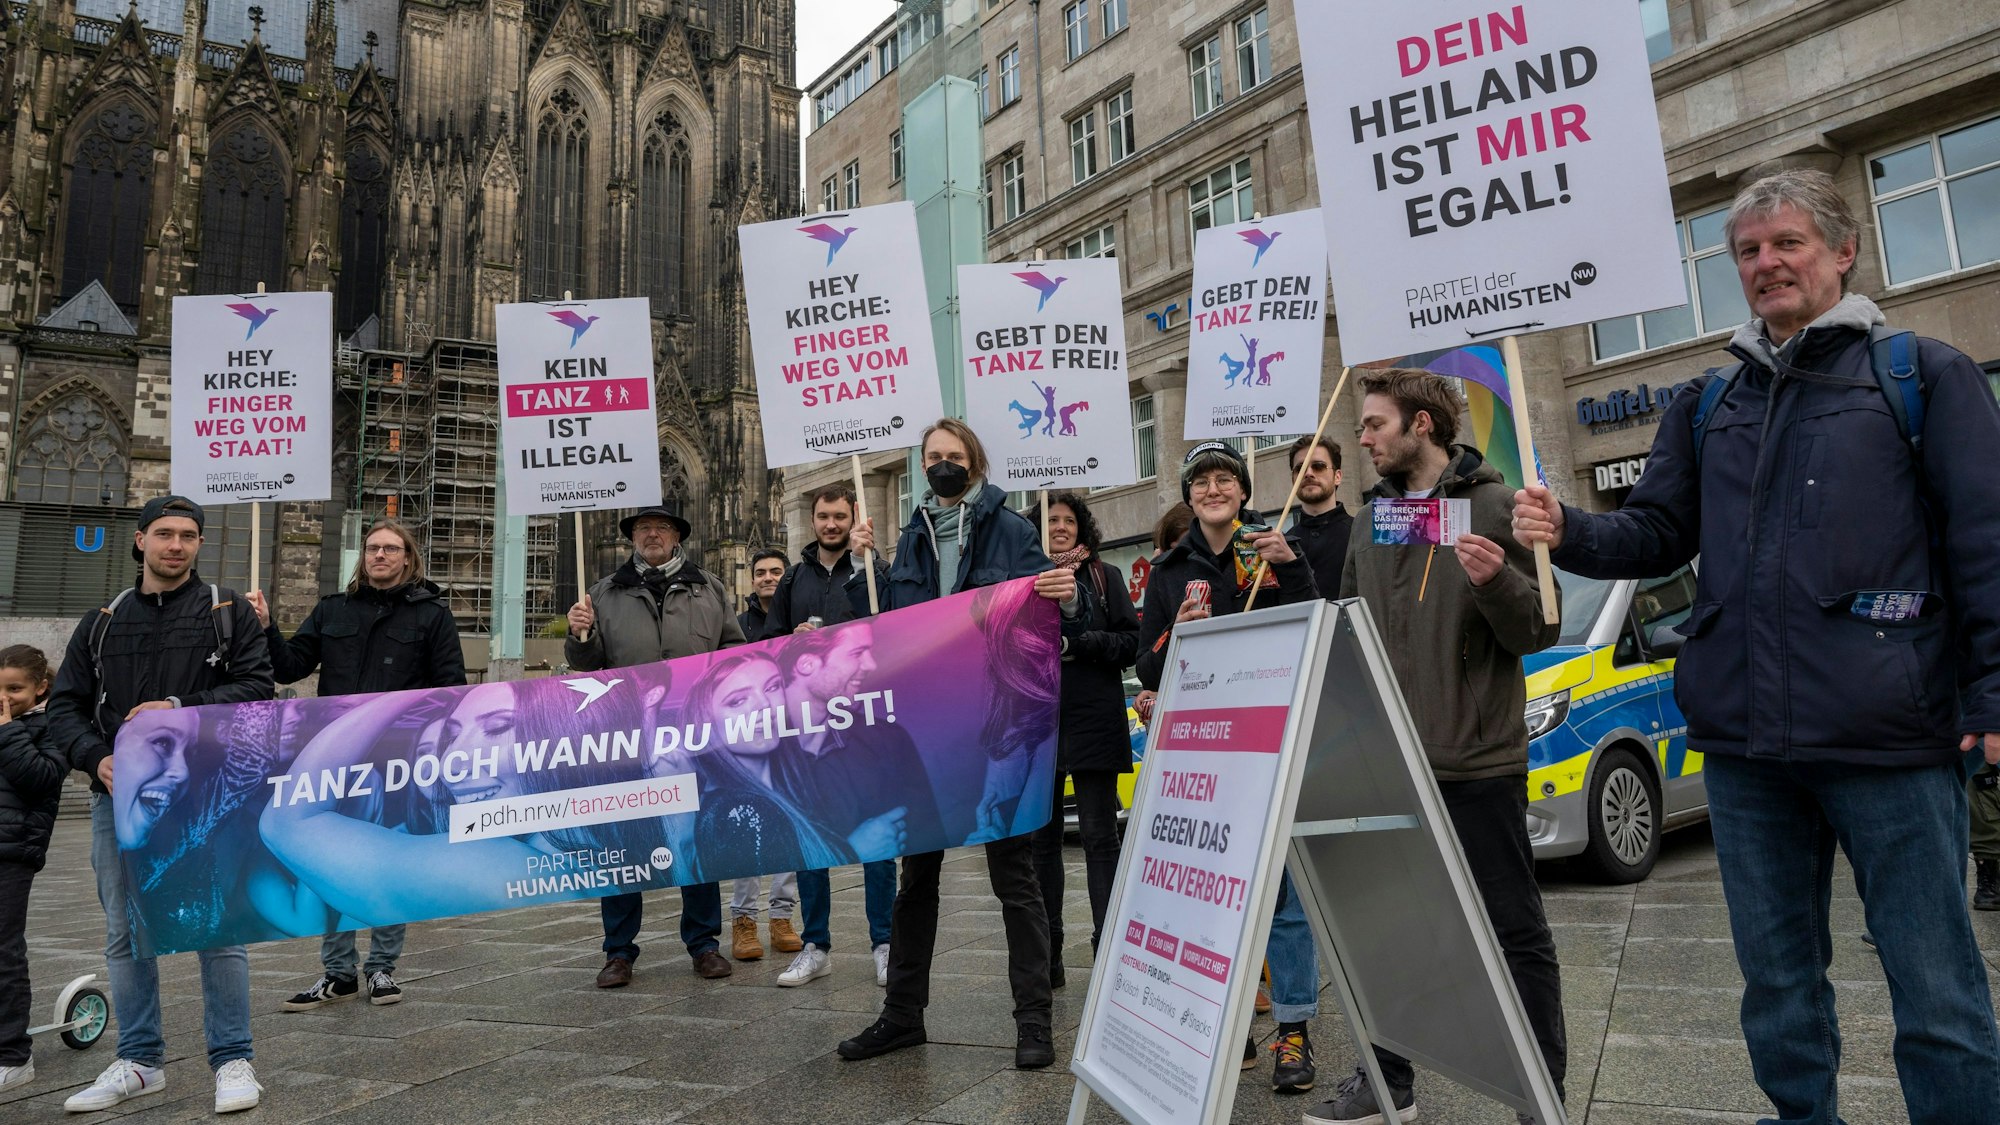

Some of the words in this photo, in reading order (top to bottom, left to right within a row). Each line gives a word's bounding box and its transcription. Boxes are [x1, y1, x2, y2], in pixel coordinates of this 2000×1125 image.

[1397, 5, 1528, 78] DEIN
[1350, 46, 1598, 144] HEILAND
[1373, 133, 1459, 191] IST
[1476, 103, 1591, 166] MIR
[1405, 162, 1572, 238] EGAL!
[809, 274, 859, 299] HEY
[1202, 280, 1258, 308] GEBT
[1264, 276, 1311, 297] DEN
[1405, 276, 1478, 307] PARTEI
[1484, 272, 1516, 291] der
[1410, 281, 1571, 328] HUMANISTEN
[1572, 265, 1595, 282] NW
[786, 296, 891, 329] KIRCHE:
[1195, 304, 1252, 332] TANZ
[1259, 301, 1318, 321] FREI!
[794, 324, 890, 356] FINGER
[976, 325, 1046, 351] GEBT
[1055, 324, 1107, 344] DEN
[228, 350, 273, 367] HEY
[545, 357, 607, 379] KEIN
[782, 358, 840, 384] WEG
[847, 347, 908, 373] VOM
[969, 350, 1043, 377] TANZ
[1052, 349, 1118, 370] FREI!
[204, 371, 297, 390] KIRCHE:
[802, 375, 896, 407] STAAT!
[208, 395, 293, 414] FINGER
[516, 386, 591, 410] TANZ
[1212, 405, 1241, 414] PARTEI
[1243, 405, 1255, 413] der
[1576, 384, 1652, 425] Gaffel
[195, 419, 245, 436] WEG
[252, 416, 306, 433] VOM
[549, 417, 592, 438] IST
[804, 420, 843, 436] PARTEI
[846, 418, 863, 429] der
[1212, 414, 1275, 426] HUMANISTEN
[1276, 407, 1286, 416] NW
[806, 426, 891, 448] HUMANISTEN
[891, 418, 903, 427] NW
[209, 438, 292, 458] STAAT!
[522, 443, 632, 469] ILLEGAL
[1007, 456, 1044, 467] PARTEI
[1046, 456, 1062, 465] der
[207, 472, 242, 482] PARTEI
[244, 472, 258, 480] der
[1008, 466, 1086, 479] HUMANISTEN
[1087, 459, 1098, 467] NW
[207, 481, 282, 493] HUMANISTEN
[283, 475, 294, 483] NW
[541, 481, 575, 491] PARTEI
[578, 481, 592, 489] der
[542, 489, 615, 502] HUMANISTEN
[616, 483, 626, 491] NW
[74, 525, 105, 553] U
[1170, 722, 1191, 739] HIER
[1199, 721, 1232, 739] HEUTE
[267, 763, 374, 808] TANZ
[385, 746, 499, 793] DOCH
[514, 729, 641, 774] WANN
[654, 723, 711, 755] DU
[725, 690, 896, 745] WILLST!
[1161, 771, 1218, 802] TANZEN
[481, 784, 681, 832] pdh.nrw/tanzverbot
[1152, 814, 1197, 847] GEGEN
[1198, 820, 1230, 853] DAS
[527, 850, 594, 875] PARTEI
[598, 847, 627, 865] der
[506, 864, 651, 899] HUMANISTEN
[653, 852, 671, 865] NW
[1142, 856, 1246, 911] TANZVERBOT!
[1163, 940, 1175, 954] UHR
[1184, 949, 1211, 970] VORPLATZ
[1212, 962, 1226, 975] HBF
[1189, 1013, 1212, 1037] Snacks
